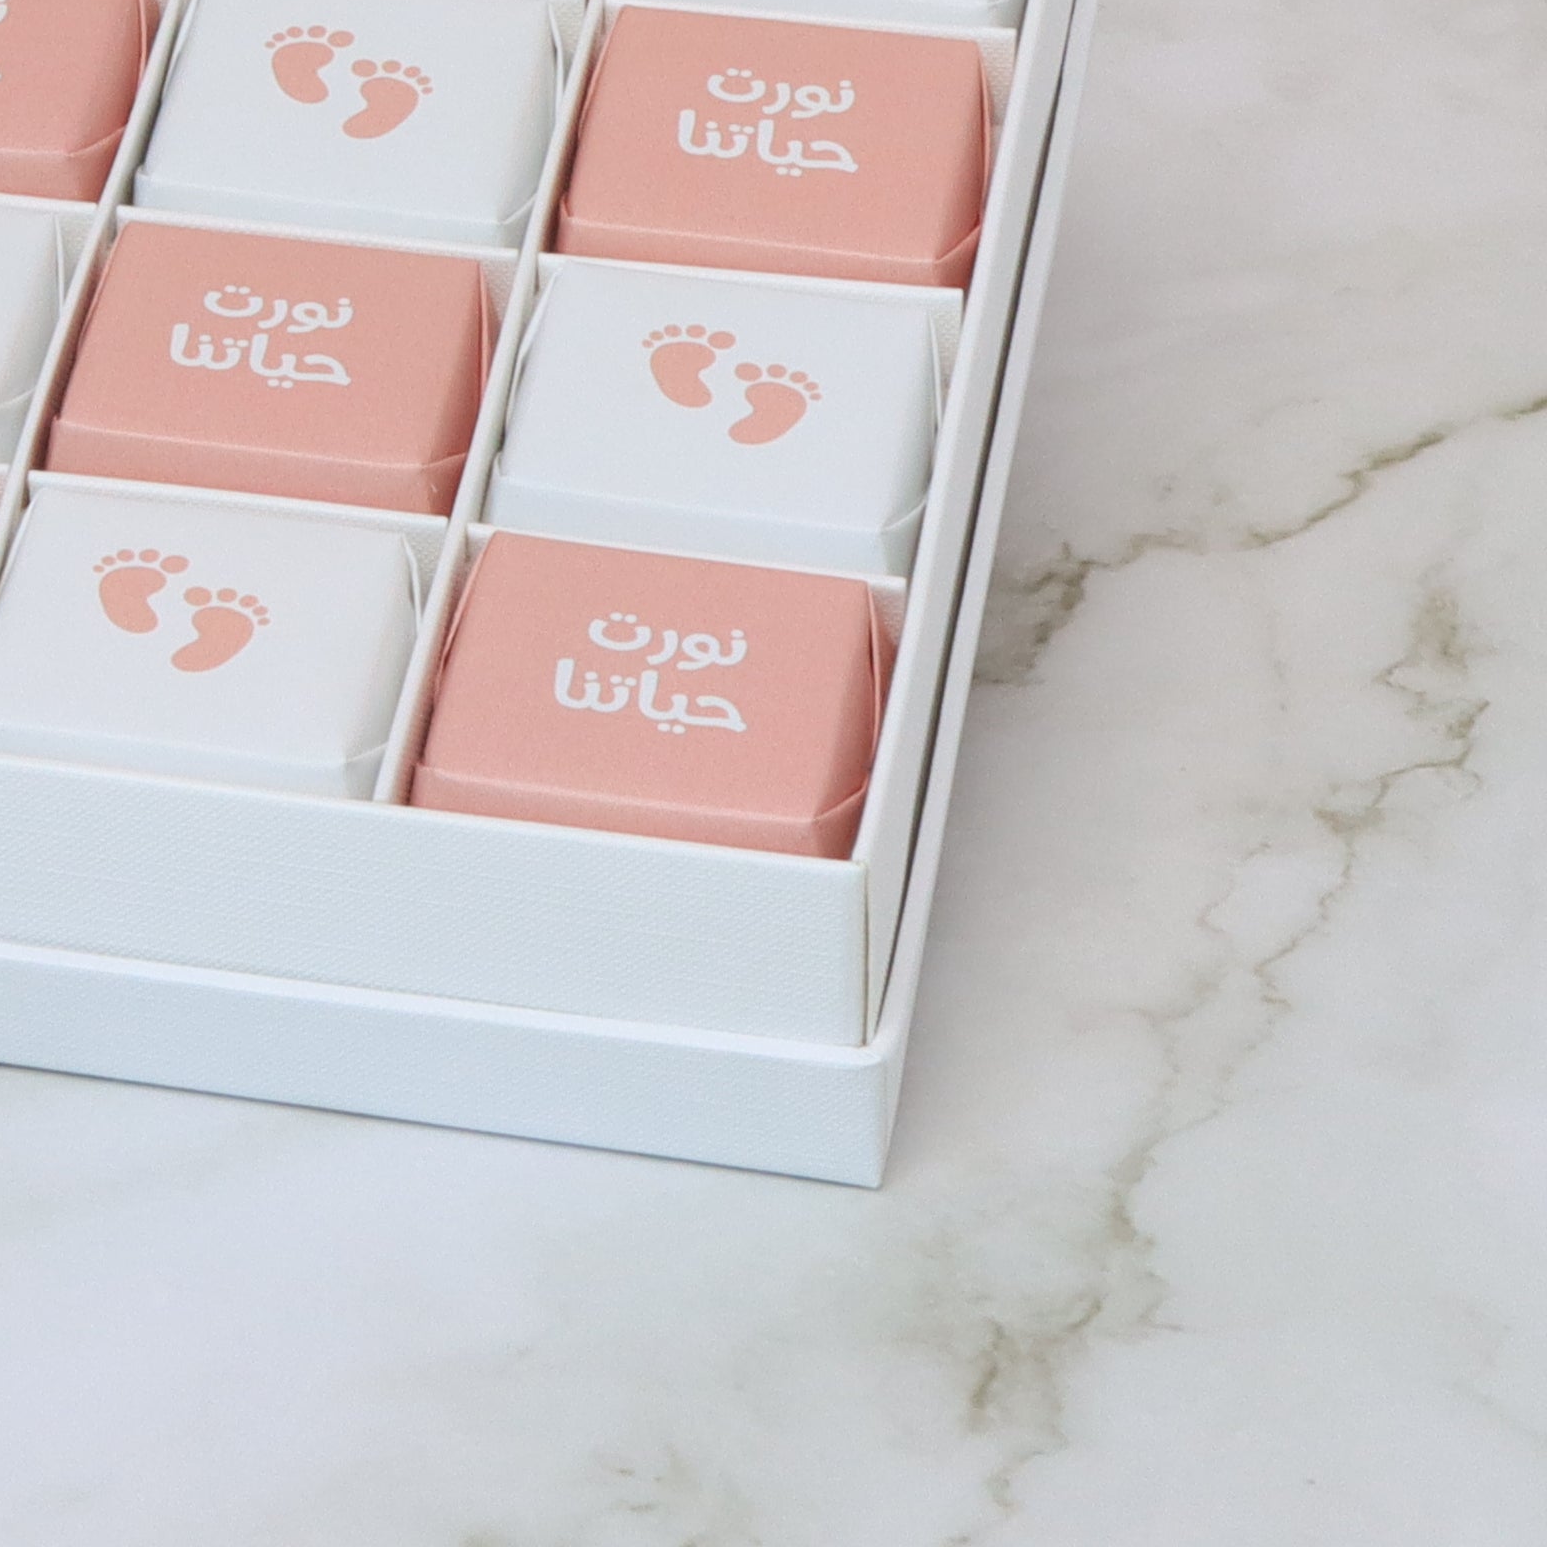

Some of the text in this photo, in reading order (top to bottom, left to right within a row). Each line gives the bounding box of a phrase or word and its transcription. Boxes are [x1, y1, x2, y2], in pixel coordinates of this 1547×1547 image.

[707, 68, 856, 120] نورت
[677, 109, 859, 177] حياتنا
[204, 285, 355, 334] نورت
[170, 323, 351, 389] حياتنا
[588, 612, 748, 671] نورت
[554, 658, 748, 734] حياتنا
